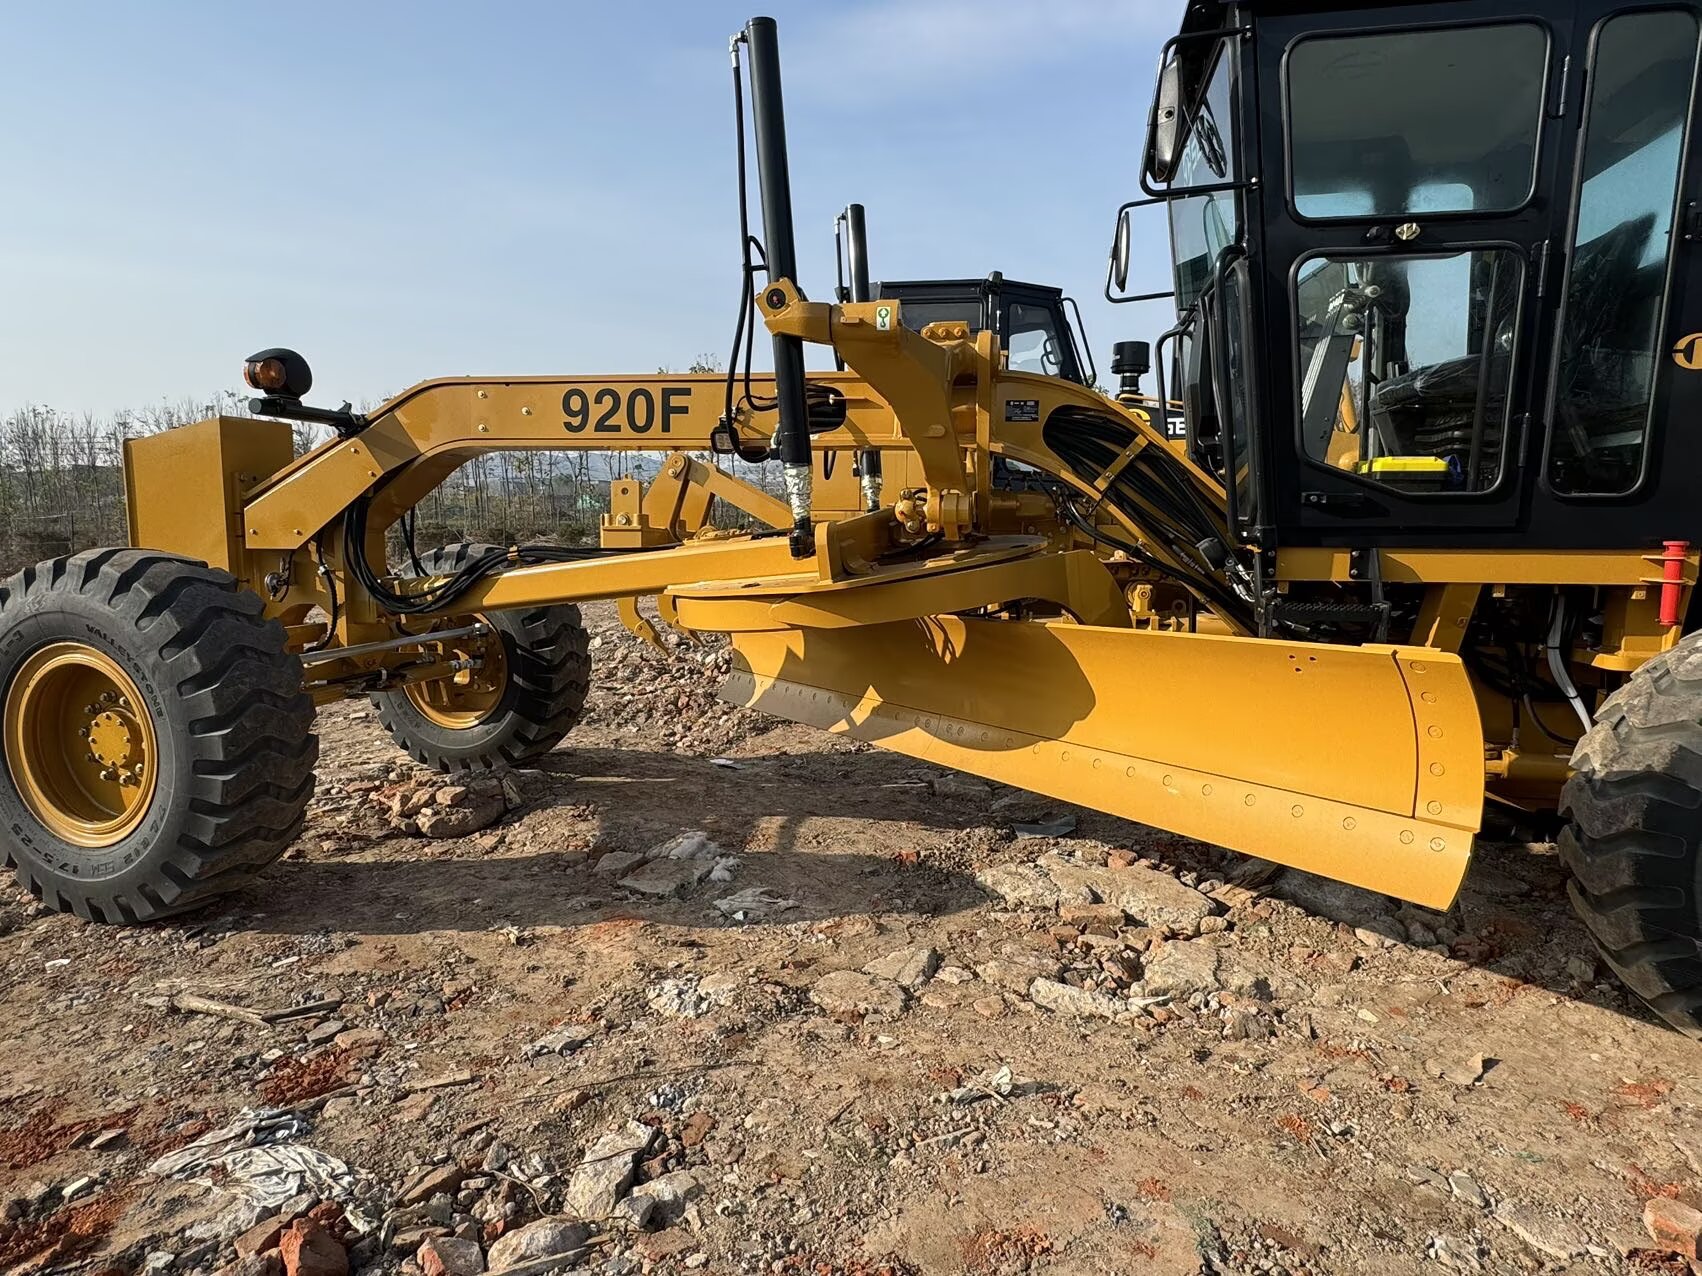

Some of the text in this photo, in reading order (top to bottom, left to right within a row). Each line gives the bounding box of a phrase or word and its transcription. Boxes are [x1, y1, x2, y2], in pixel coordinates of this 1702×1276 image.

[562, 387, 692, 434] 920F
[85, 623, 164, 718] VALLEYSTONE
[11, 822, 80, 875] 17.5-25
